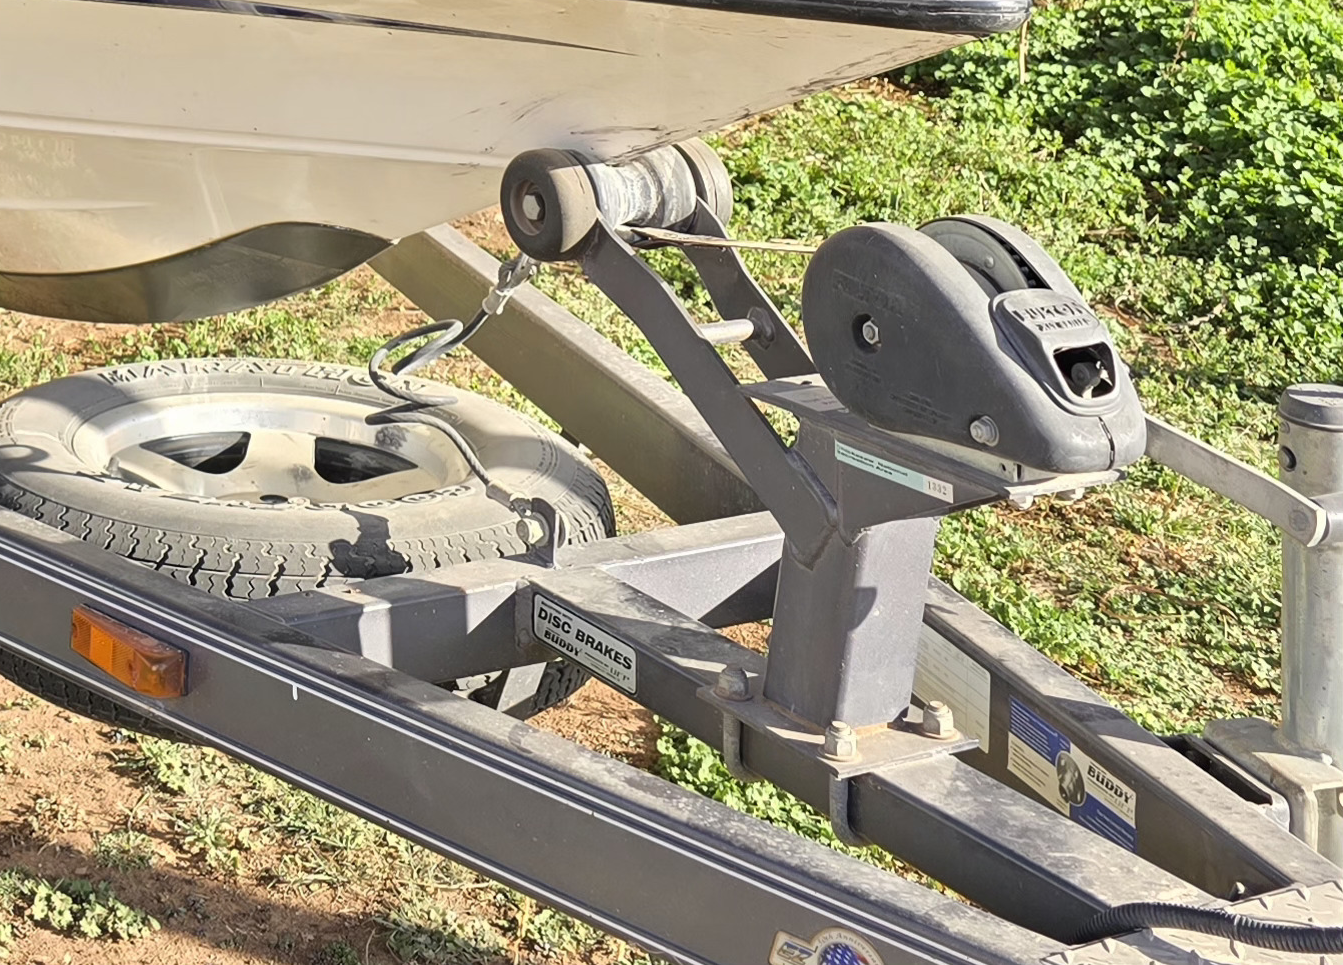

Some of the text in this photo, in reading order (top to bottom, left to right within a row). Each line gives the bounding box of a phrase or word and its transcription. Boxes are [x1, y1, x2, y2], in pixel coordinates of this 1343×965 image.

[538, 607, 572, 634] DISC
[575, 628, 633, 670] BRAKES
[544, 629, 583, 656] BUDDY
[1087, 765, 1133, 804] BUDDY
